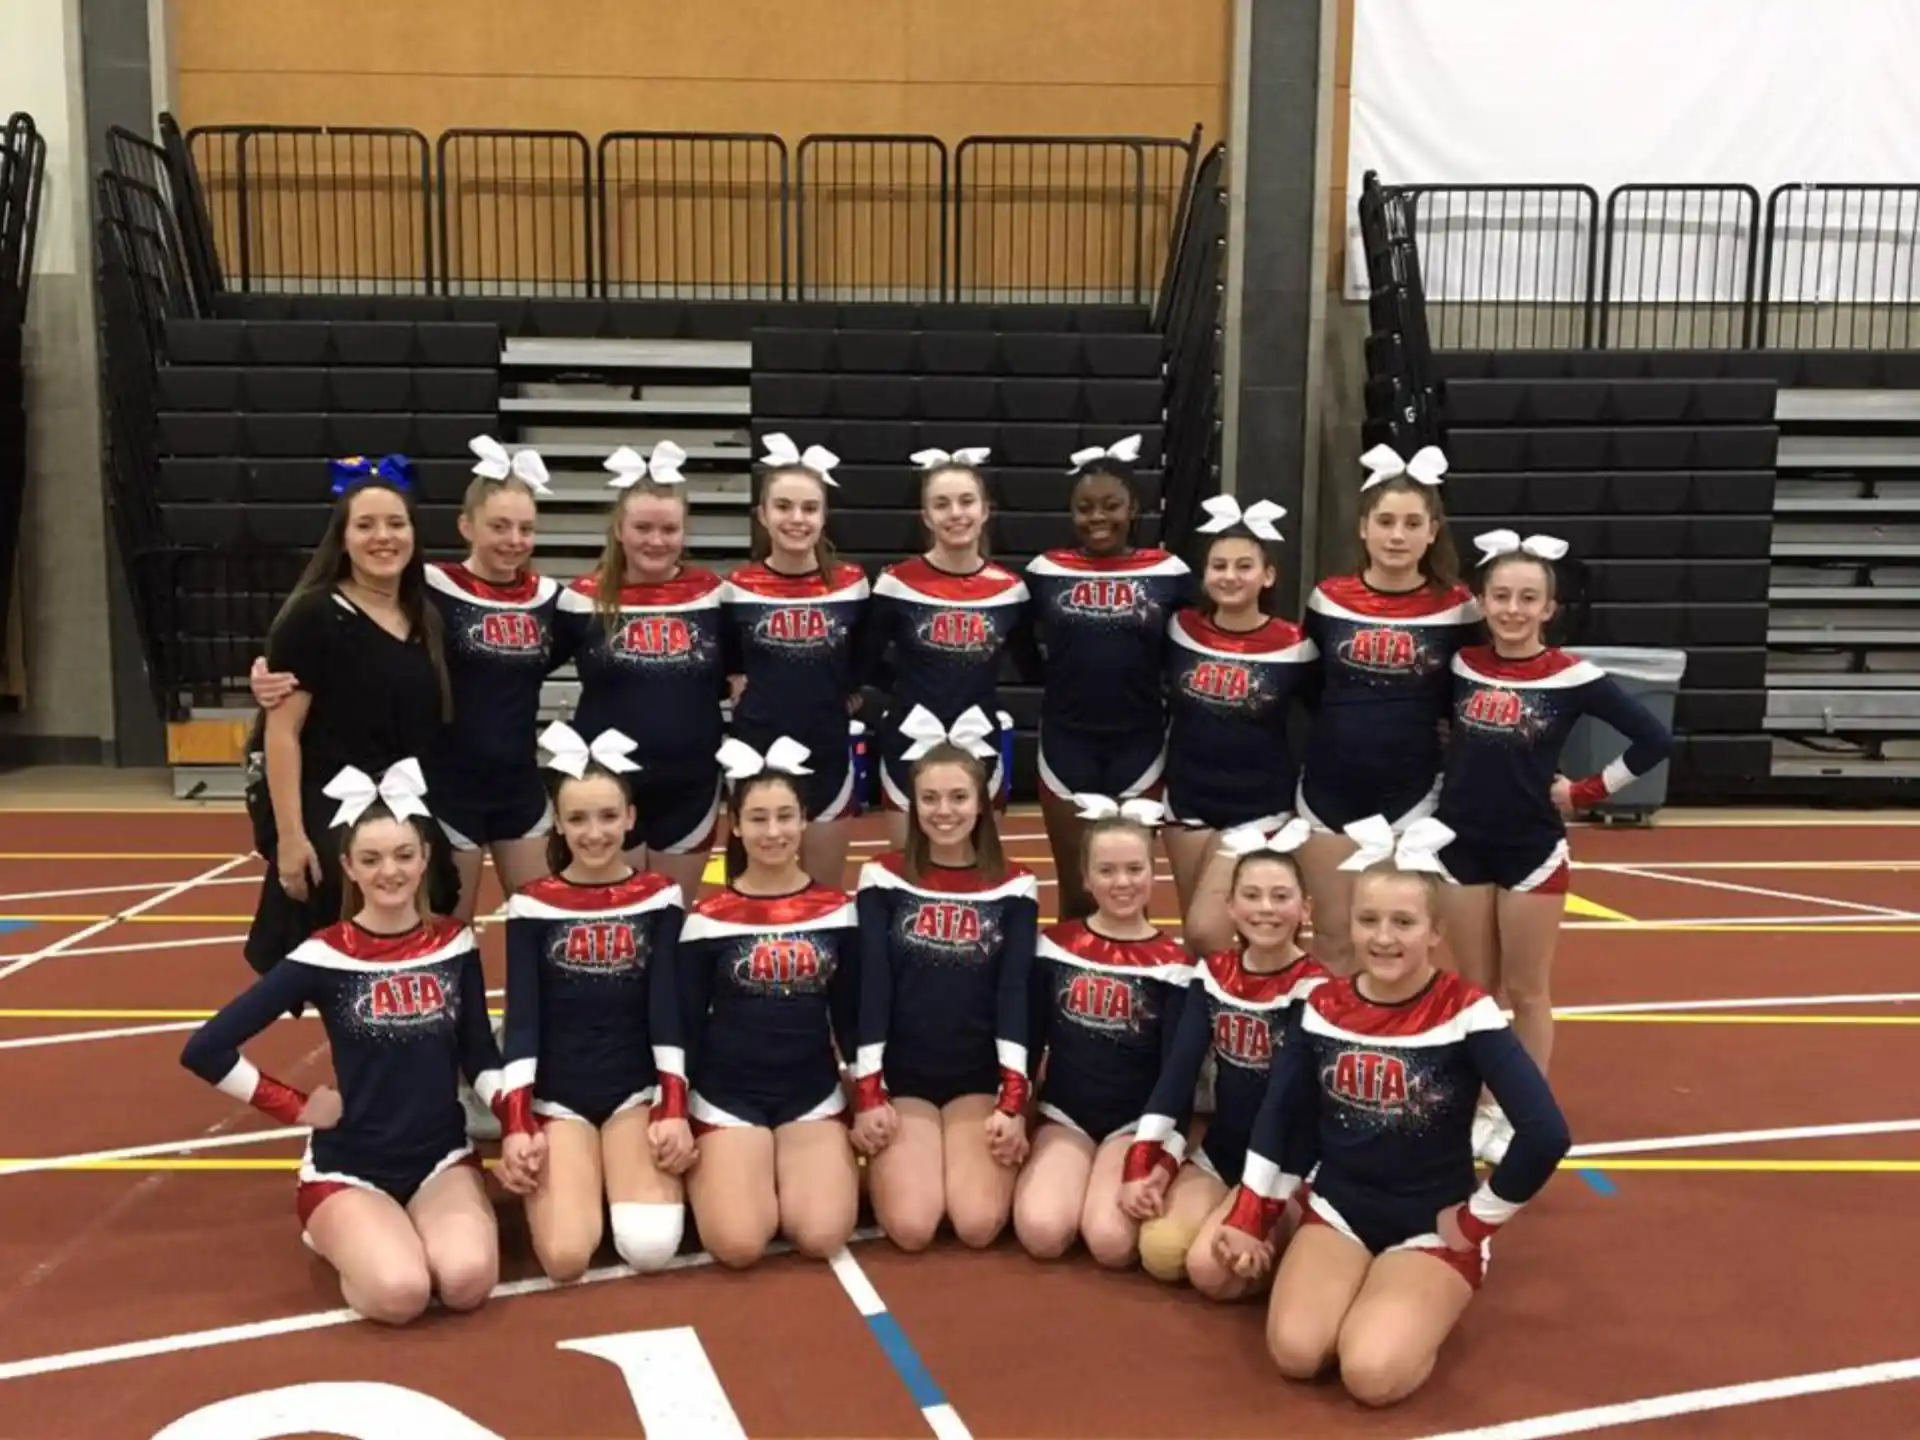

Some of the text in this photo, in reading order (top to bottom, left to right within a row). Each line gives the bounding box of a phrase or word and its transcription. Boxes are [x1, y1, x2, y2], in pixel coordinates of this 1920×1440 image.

[1070, 580, 1135, 607] ATA
[482, 612, 541, 646] ATA
[625, 617, 689, 653] ATA
[769, 608, 827, 640] ATA
[931, 612, 987, 645] ATA
[1351, 629, 1415, 666] ATA
[1192, 663, 1248, 699] ATA
[1466, 689, 1521, 724] ATA
[914, 903, 980, 941] ATA
[566, 924, 635, 962] ATA
[750, 941, 816, 979] ATA
[372, 974, 444, 1016] ATA
[1067, 976, 1131, 1020] ATA
[1215, 1013, 1270, 1058] ATA
[1334, 1052, 1408, 1101] ATA
